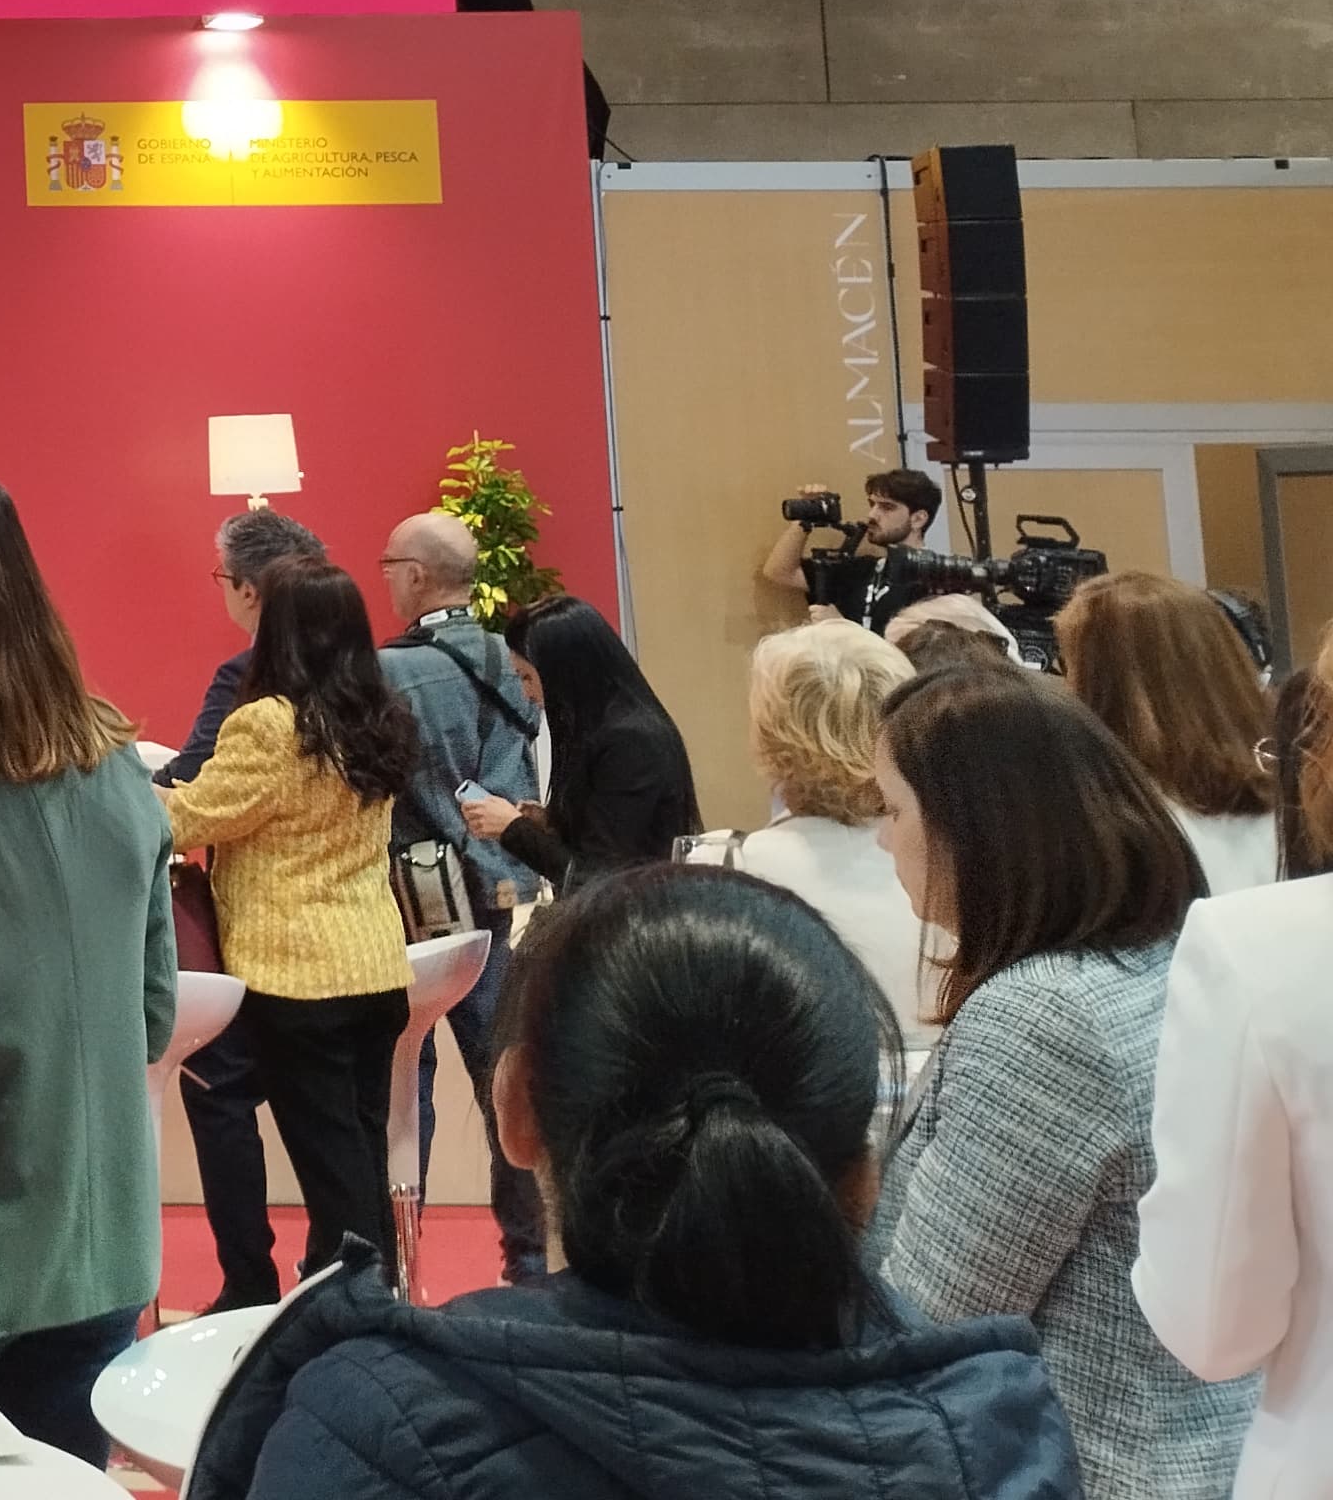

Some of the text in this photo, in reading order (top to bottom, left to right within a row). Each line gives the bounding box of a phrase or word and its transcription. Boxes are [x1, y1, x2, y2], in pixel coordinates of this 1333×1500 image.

[137, 138, 211, 150] GOBIERNO
[249, 137, 327, 148] MINISTERIO
[137, 153, 156, 164] DE
[376, 151, 419, 162] PESCA
[263, 165, 368, 179] ALIMENTACIÓN
[832, 212, 886, 464] ALMACÉN
